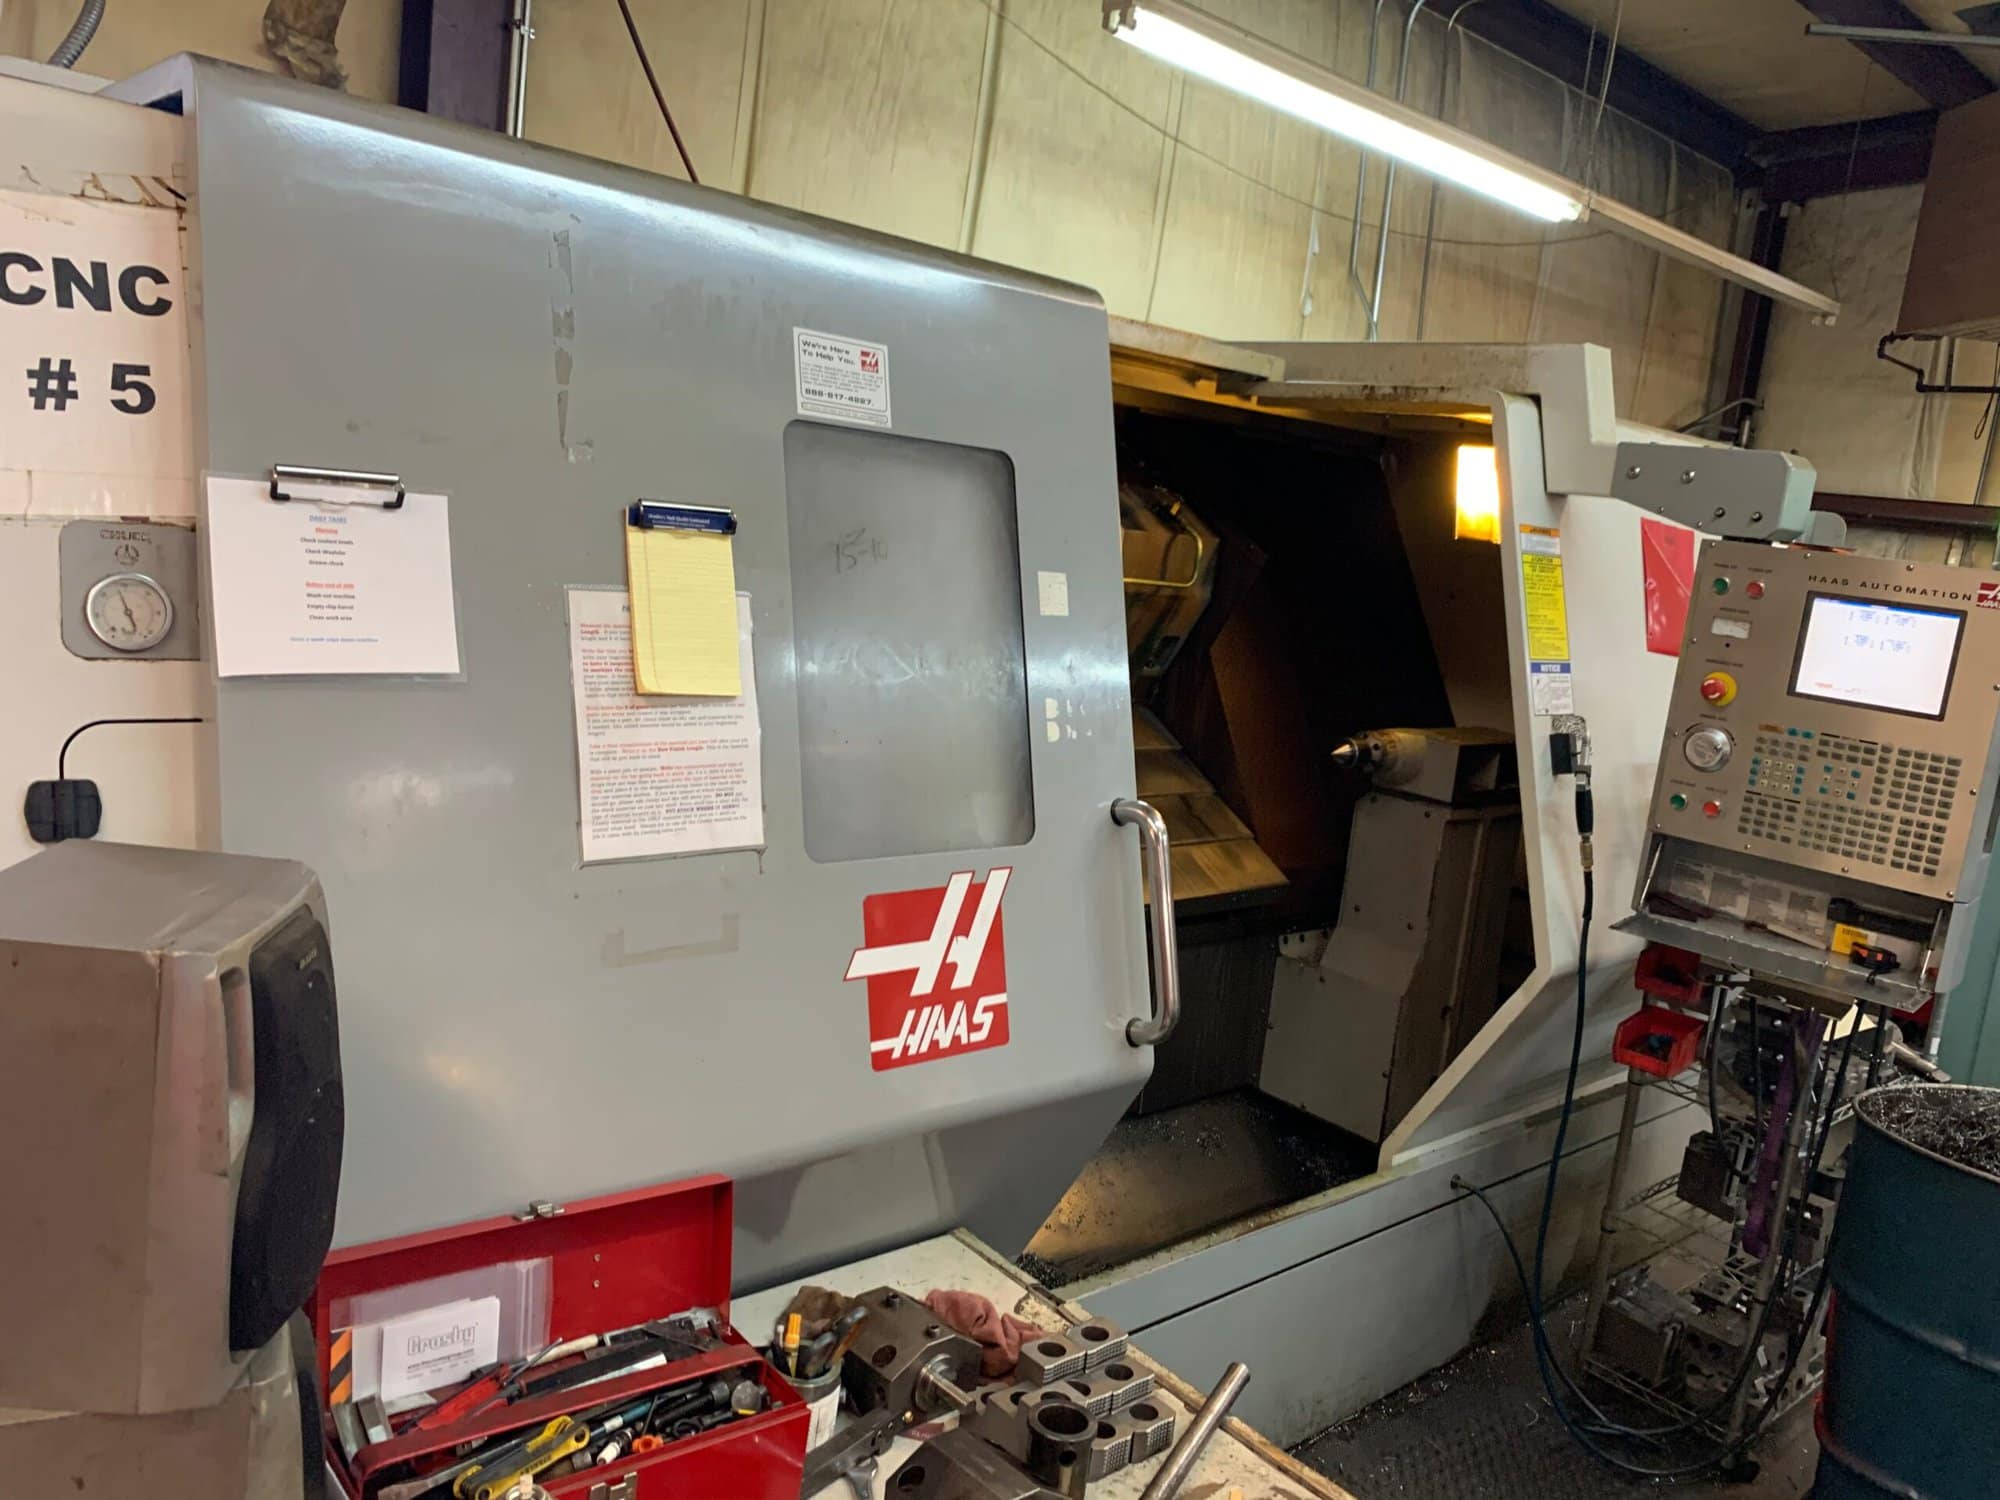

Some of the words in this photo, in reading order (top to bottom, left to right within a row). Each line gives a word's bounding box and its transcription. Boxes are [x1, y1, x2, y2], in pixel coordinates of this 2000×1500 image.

[0, 252, 173, 316] CNC
[801, 340, 827, 350] We're
[829, 345, 850, 355] Here
[802, 349, 813, 357] To
[816, 350, 834, 361] Help
[26, 357, 79, 411] #
[110, 363, 156, 415] 5
[1808, 575, 1849, 586] HAAS
[1860, 581, 1972, 601] AUTOMATION
[870, 992, 1008, 1060] HAAS
